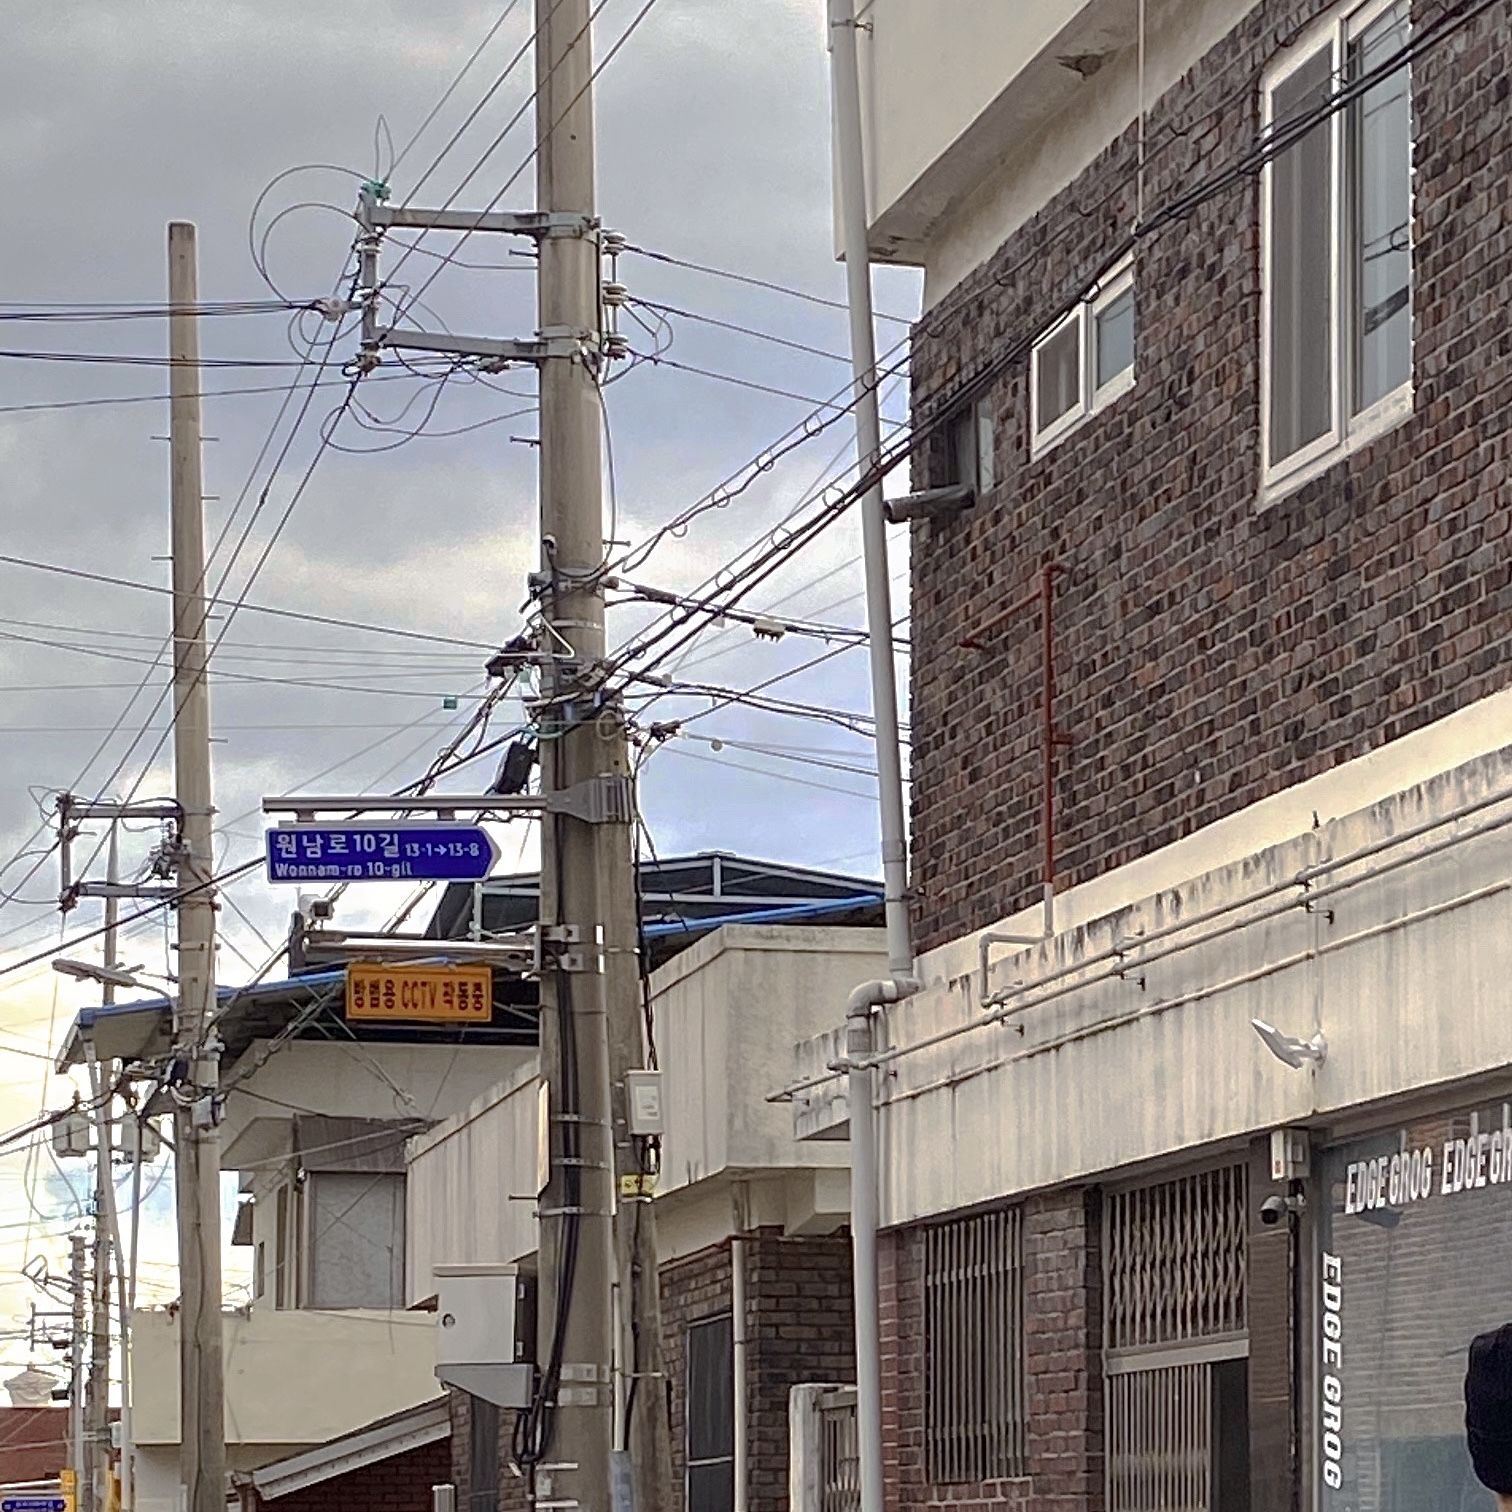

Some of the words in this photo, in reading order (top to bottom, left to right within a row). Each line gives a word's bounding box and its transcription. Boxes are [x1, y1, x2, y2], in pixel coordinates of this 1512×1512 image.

[449, 842, 480, 857] 13-8
[401, 980, 437, 1010] CCTV
[1345, 1155, 1389, 1214] EDGE
[1388, 1146, 1432, 1205] GROG
[1441, 1133, 1489, 1195] EDGE
[1322, 1252, 1342, 1369] EDGE
[1323, 1374, 1343, 1490] GROG
